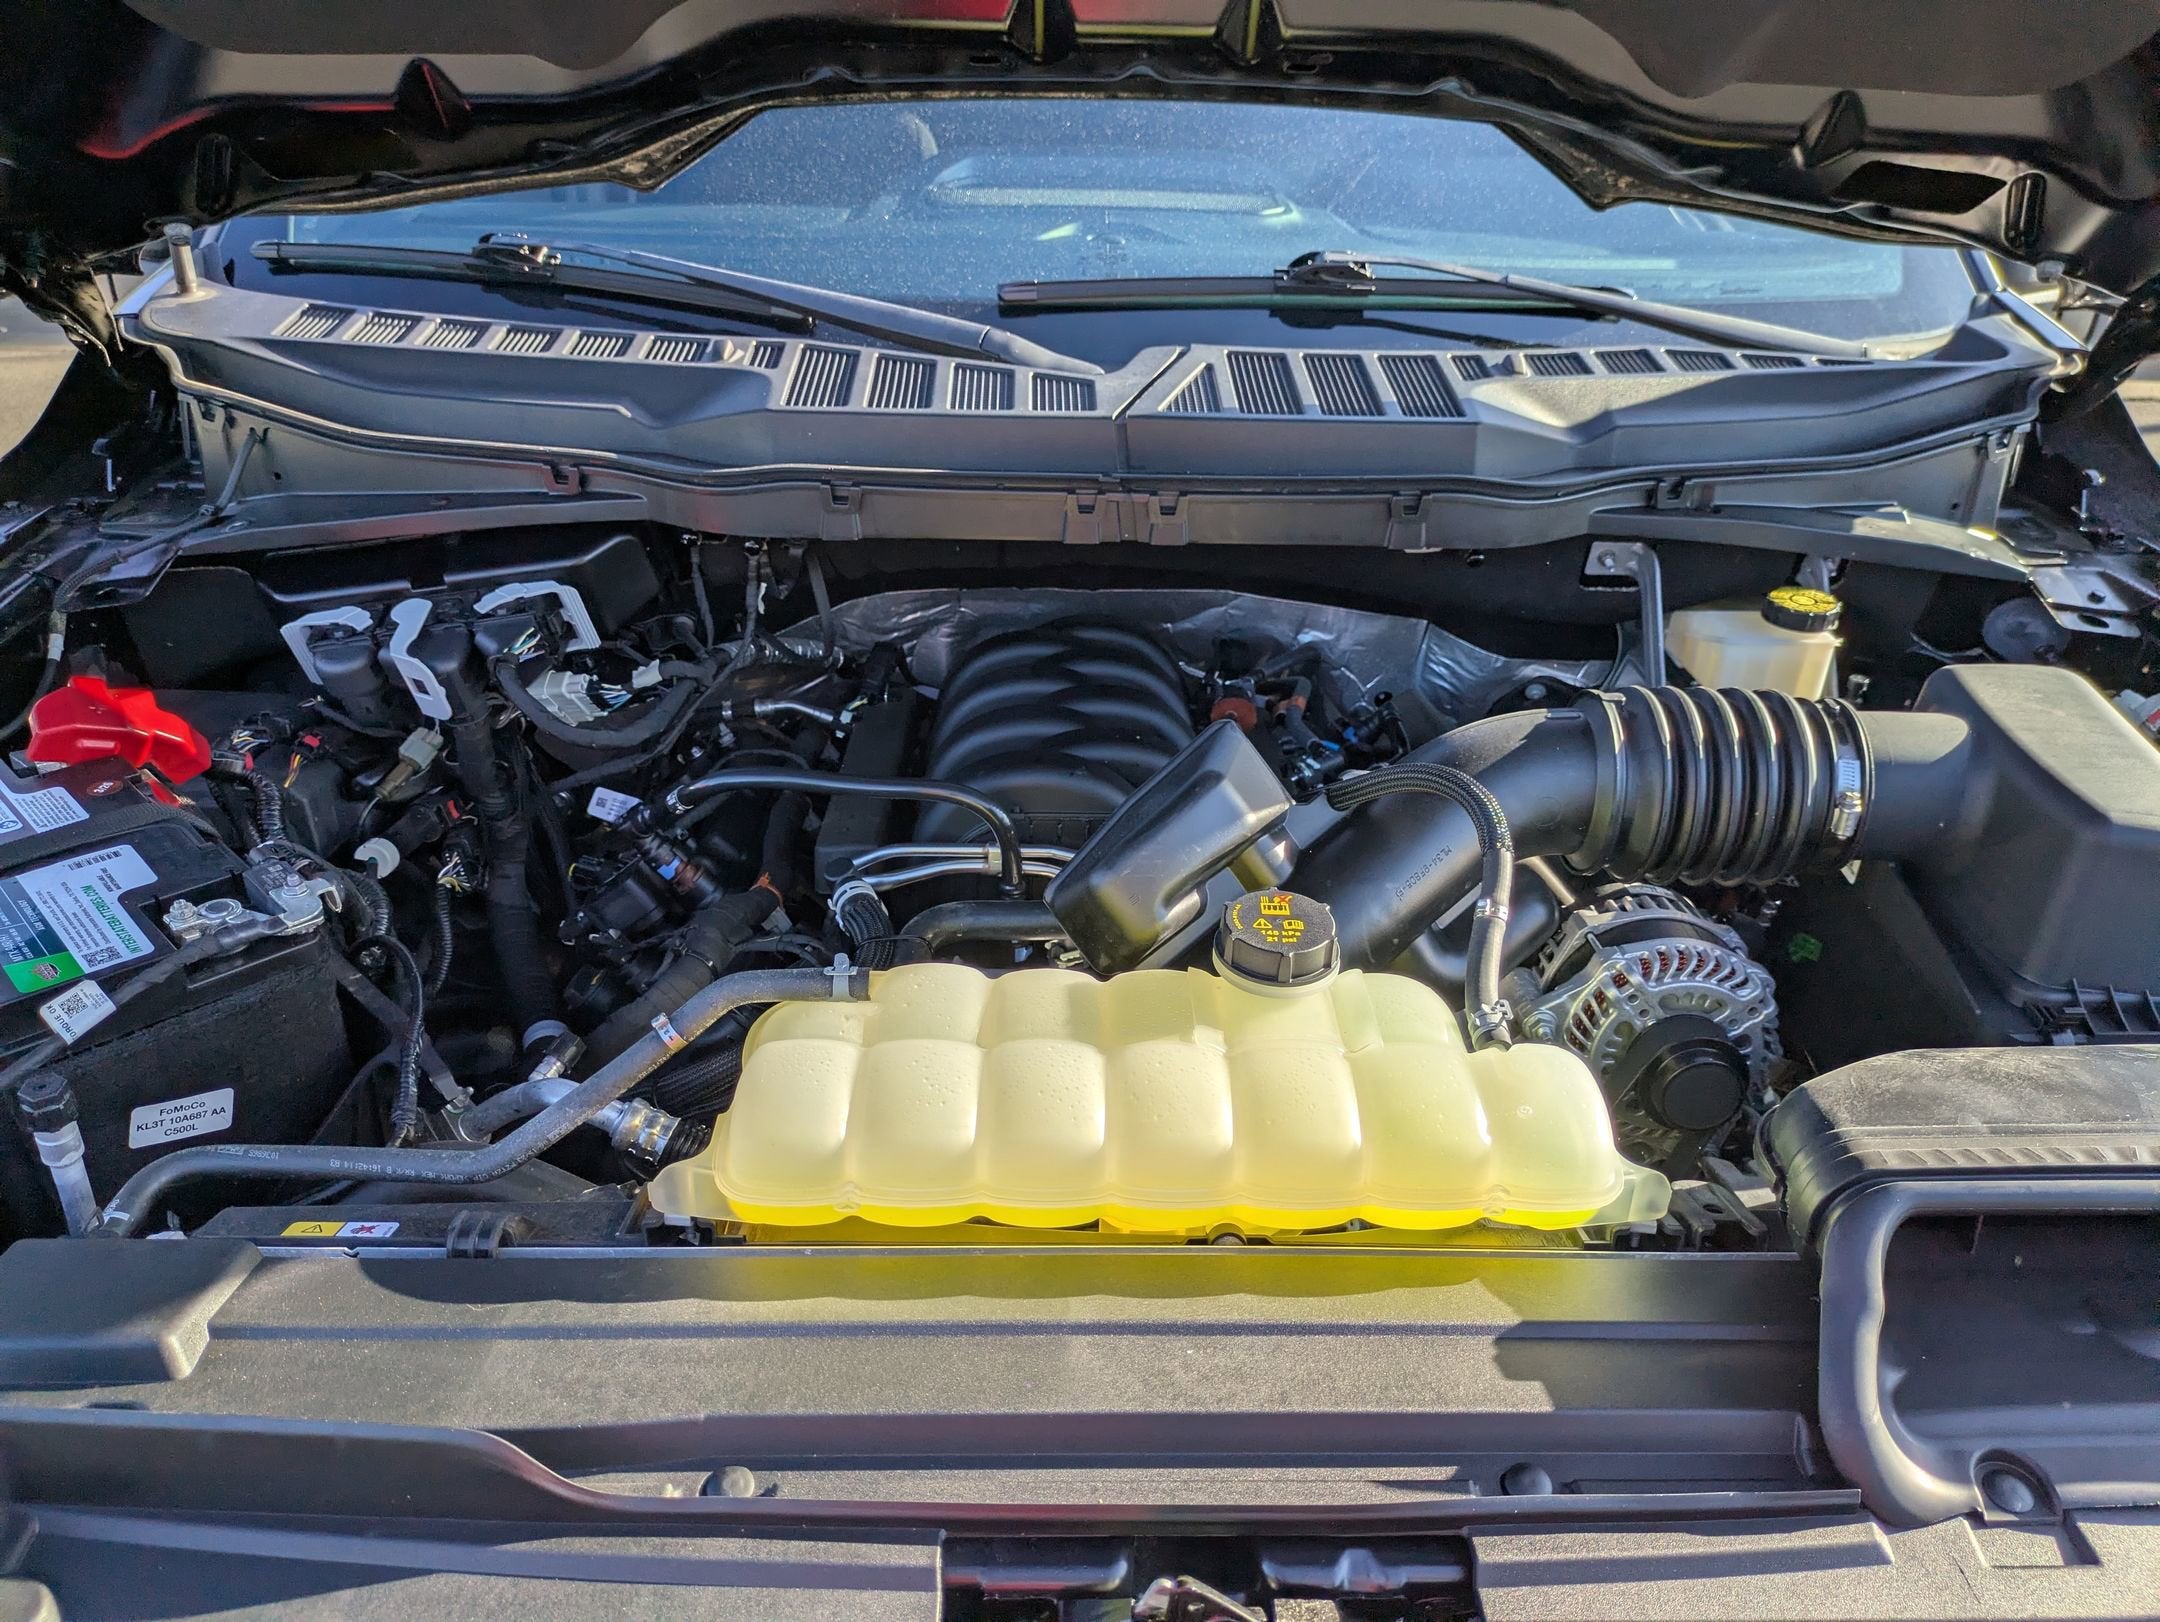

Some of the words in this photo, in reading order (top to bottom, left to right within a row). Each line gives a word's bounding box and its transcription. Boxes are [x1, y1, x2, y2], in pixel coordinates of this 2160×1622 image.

[80, 884, 144, 954] INTERSTATEBATTERIES.COM
[46, 1003, 57, 1014] OK
[159, 1101, 206, 1116] FoMoCo
[136, 1119, 166, 1132] KL3T
[170, 1110, 209, 1125] 10A687
[211, 1106, 226, 1116] AA
[164, 1123, 199, 1137] C500L
